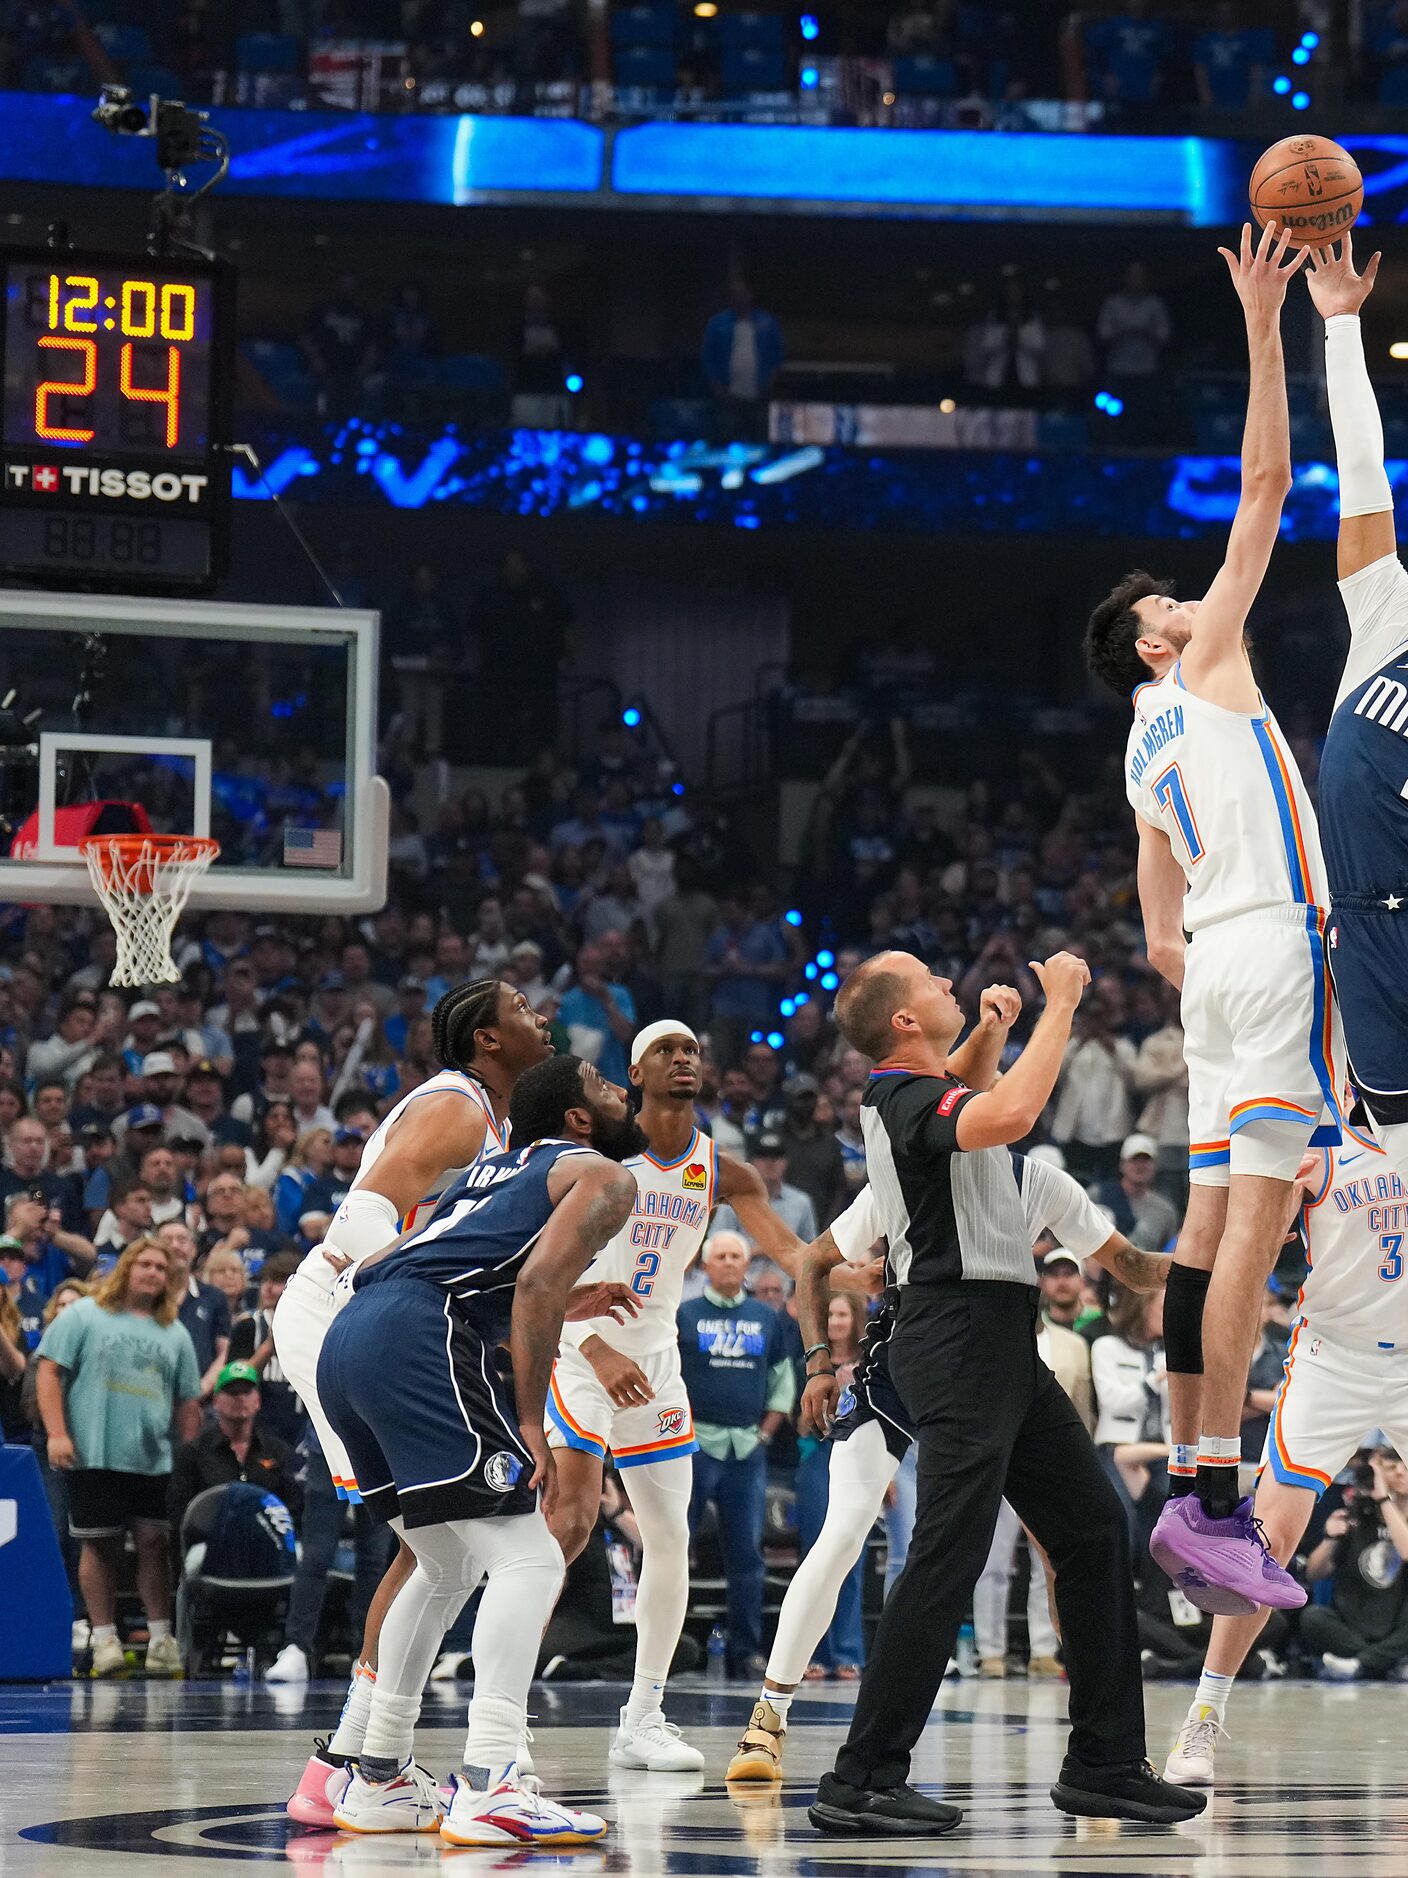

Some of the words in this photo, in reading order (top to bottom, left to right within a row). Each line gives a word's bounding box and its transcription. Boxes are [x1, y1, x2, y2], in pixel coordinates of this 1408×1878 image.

[1281, 203, 1354, 230] Wilson
[49, 274, 195, 341] 12:00
[35, 336, 181, 448] 24
[62, 466, 208, 503] TISSOT
[1130, 705, 1185, 788] HOLMGREN
[1151, 761, 1206, 865] 7
[683, 1178, 705, 1188] Love's
[631, 1190, 708, 1230] LAHOMA
[630, 1221, 678, 1249] CITY
[1378, 1232, 1405, 1282] 3
[631, 1250, 662, 1298] 2
[661, 1411, 681, 1431] OKC
